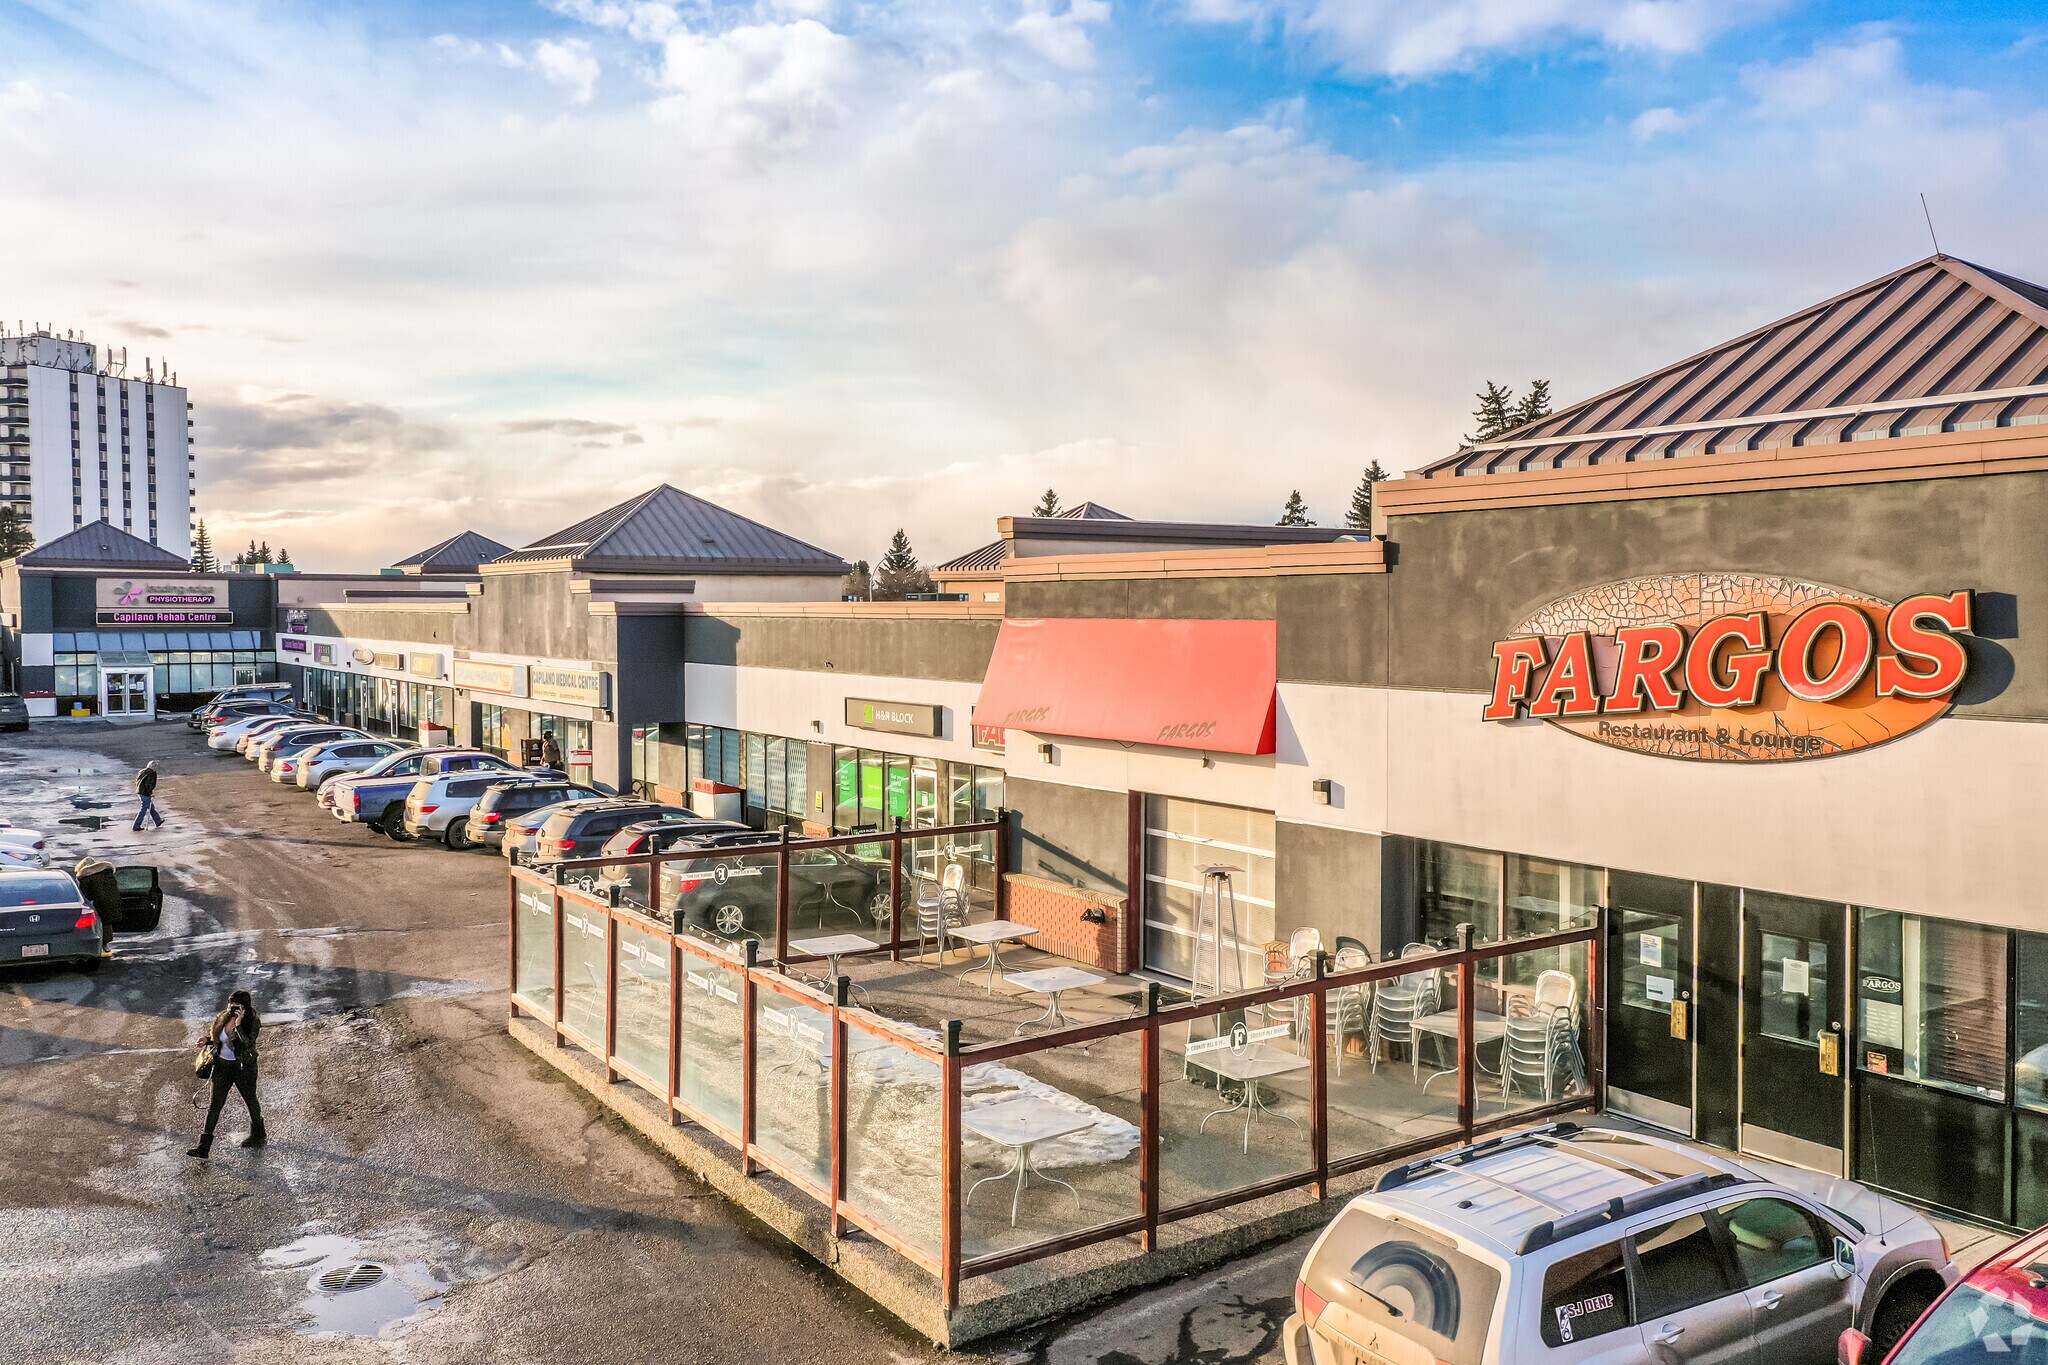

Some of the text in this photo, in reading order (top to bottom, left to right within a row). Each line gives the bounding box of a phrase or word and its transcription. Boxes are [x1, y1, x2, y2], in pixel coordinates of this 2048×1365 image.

[113, 612, 217, 622] Capilano Rehab Centre
[1482, 589, 1976, 723] FARGOS
[533, 670, 599, 690] CAPILANO MEDICAL CENTRE
[875, 710, 914, 724] H&R BLOCK
[1002, 706, 1051, 726] FARGOS
[1156, 721, 1217, 742] FARGOS
[1599, 720, 1822, 753] Restaurant & Lounge
[858, 849, 880, 857] OPEN
[1862, 978, 1902, 991] FARGOS
[1566, 1301, 1584, 1318] SJ
